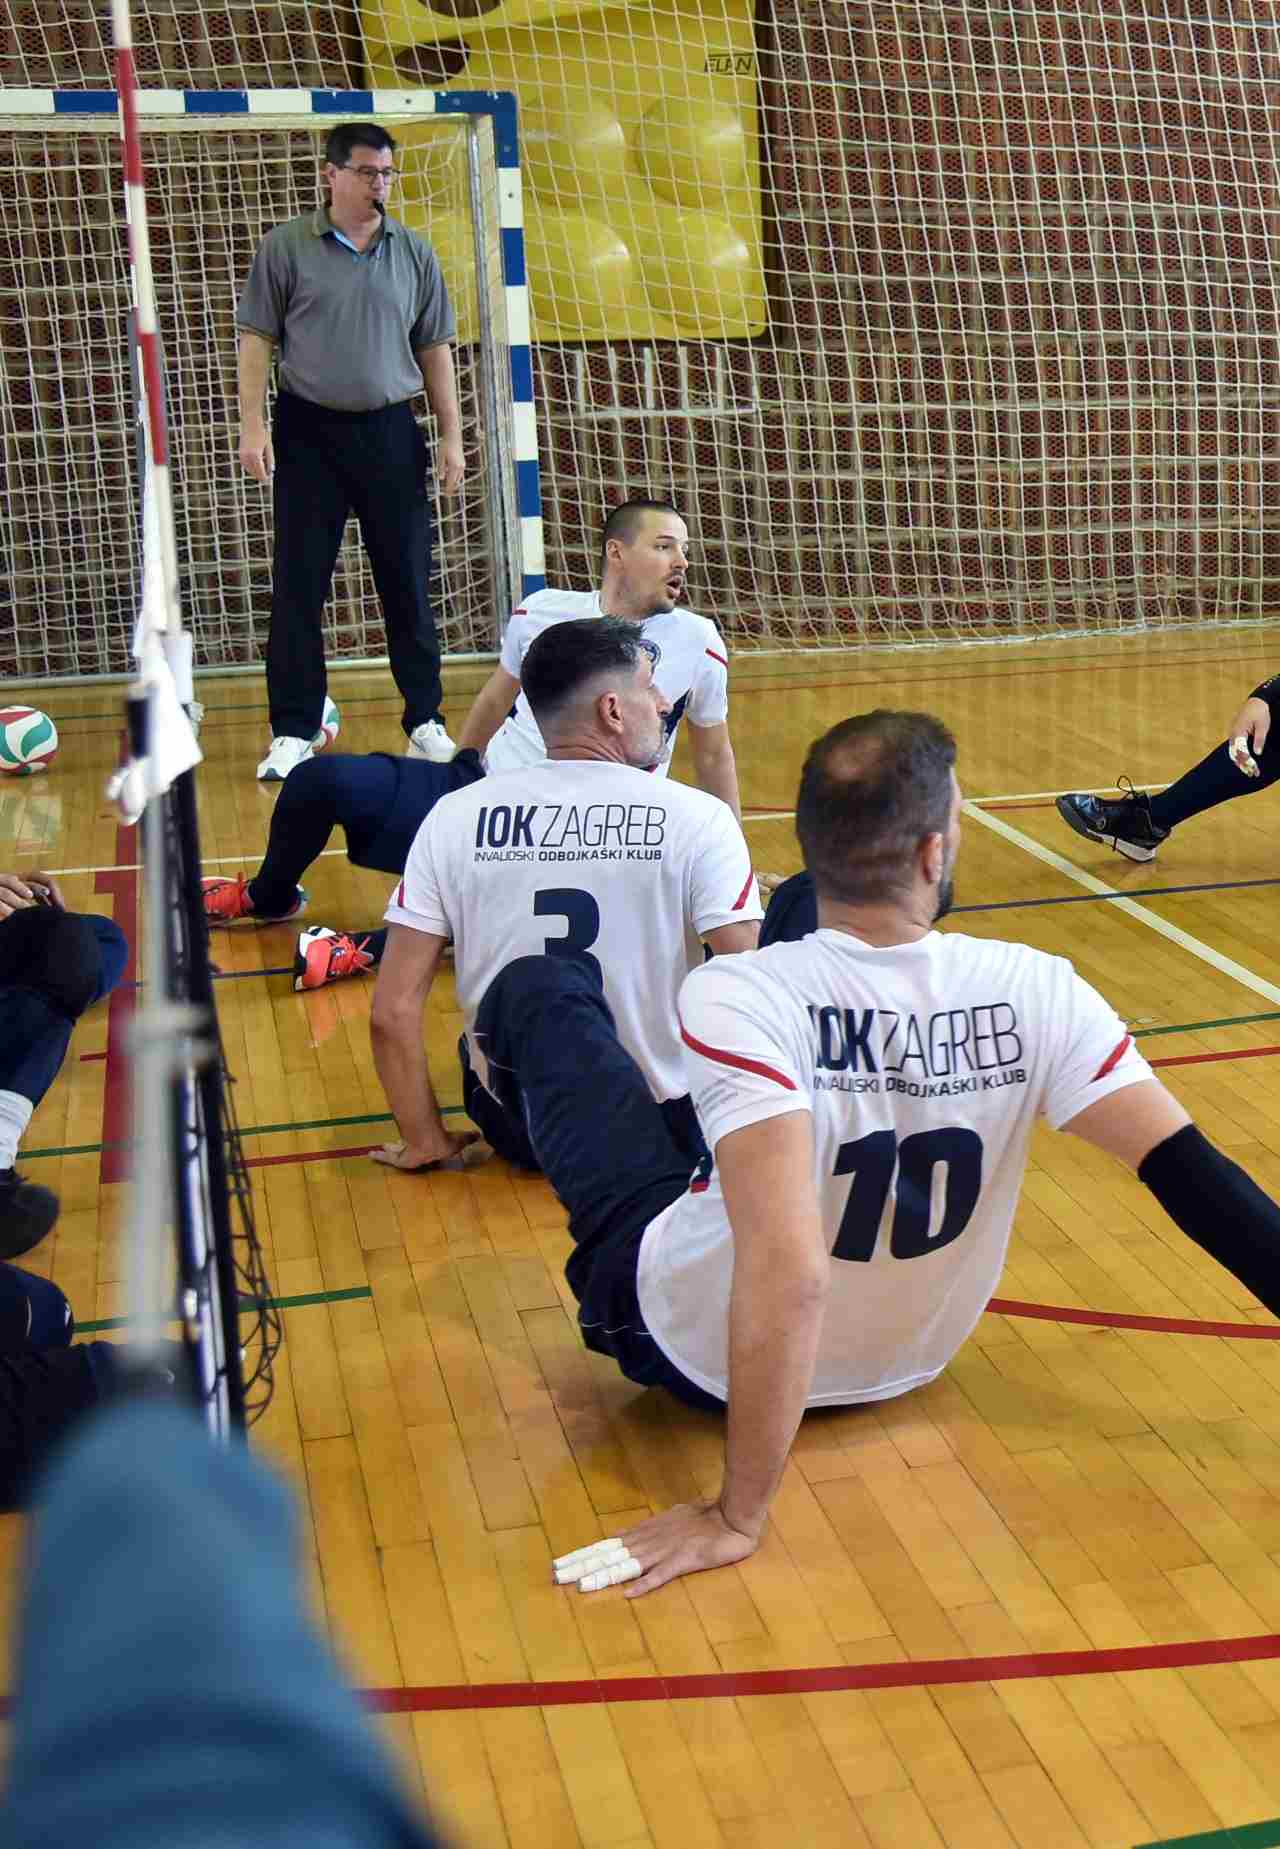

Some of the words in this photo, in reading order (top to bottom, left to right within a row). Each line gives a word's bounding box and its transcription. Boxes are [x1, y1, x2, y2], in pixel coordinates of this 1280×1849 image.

[540, 804, 666, 847] ZAGREB
[538, 848, 622, 862] ODBOJKAŠKI
[626, 850, 662, 861] KLUB
[533, 888, 600, 956] 3
[878, 1002, 1022, 1079] ZAGREB
[982, 1069, 1027, 1091] KLUB
[830, 1126, 984, 1263] 10
